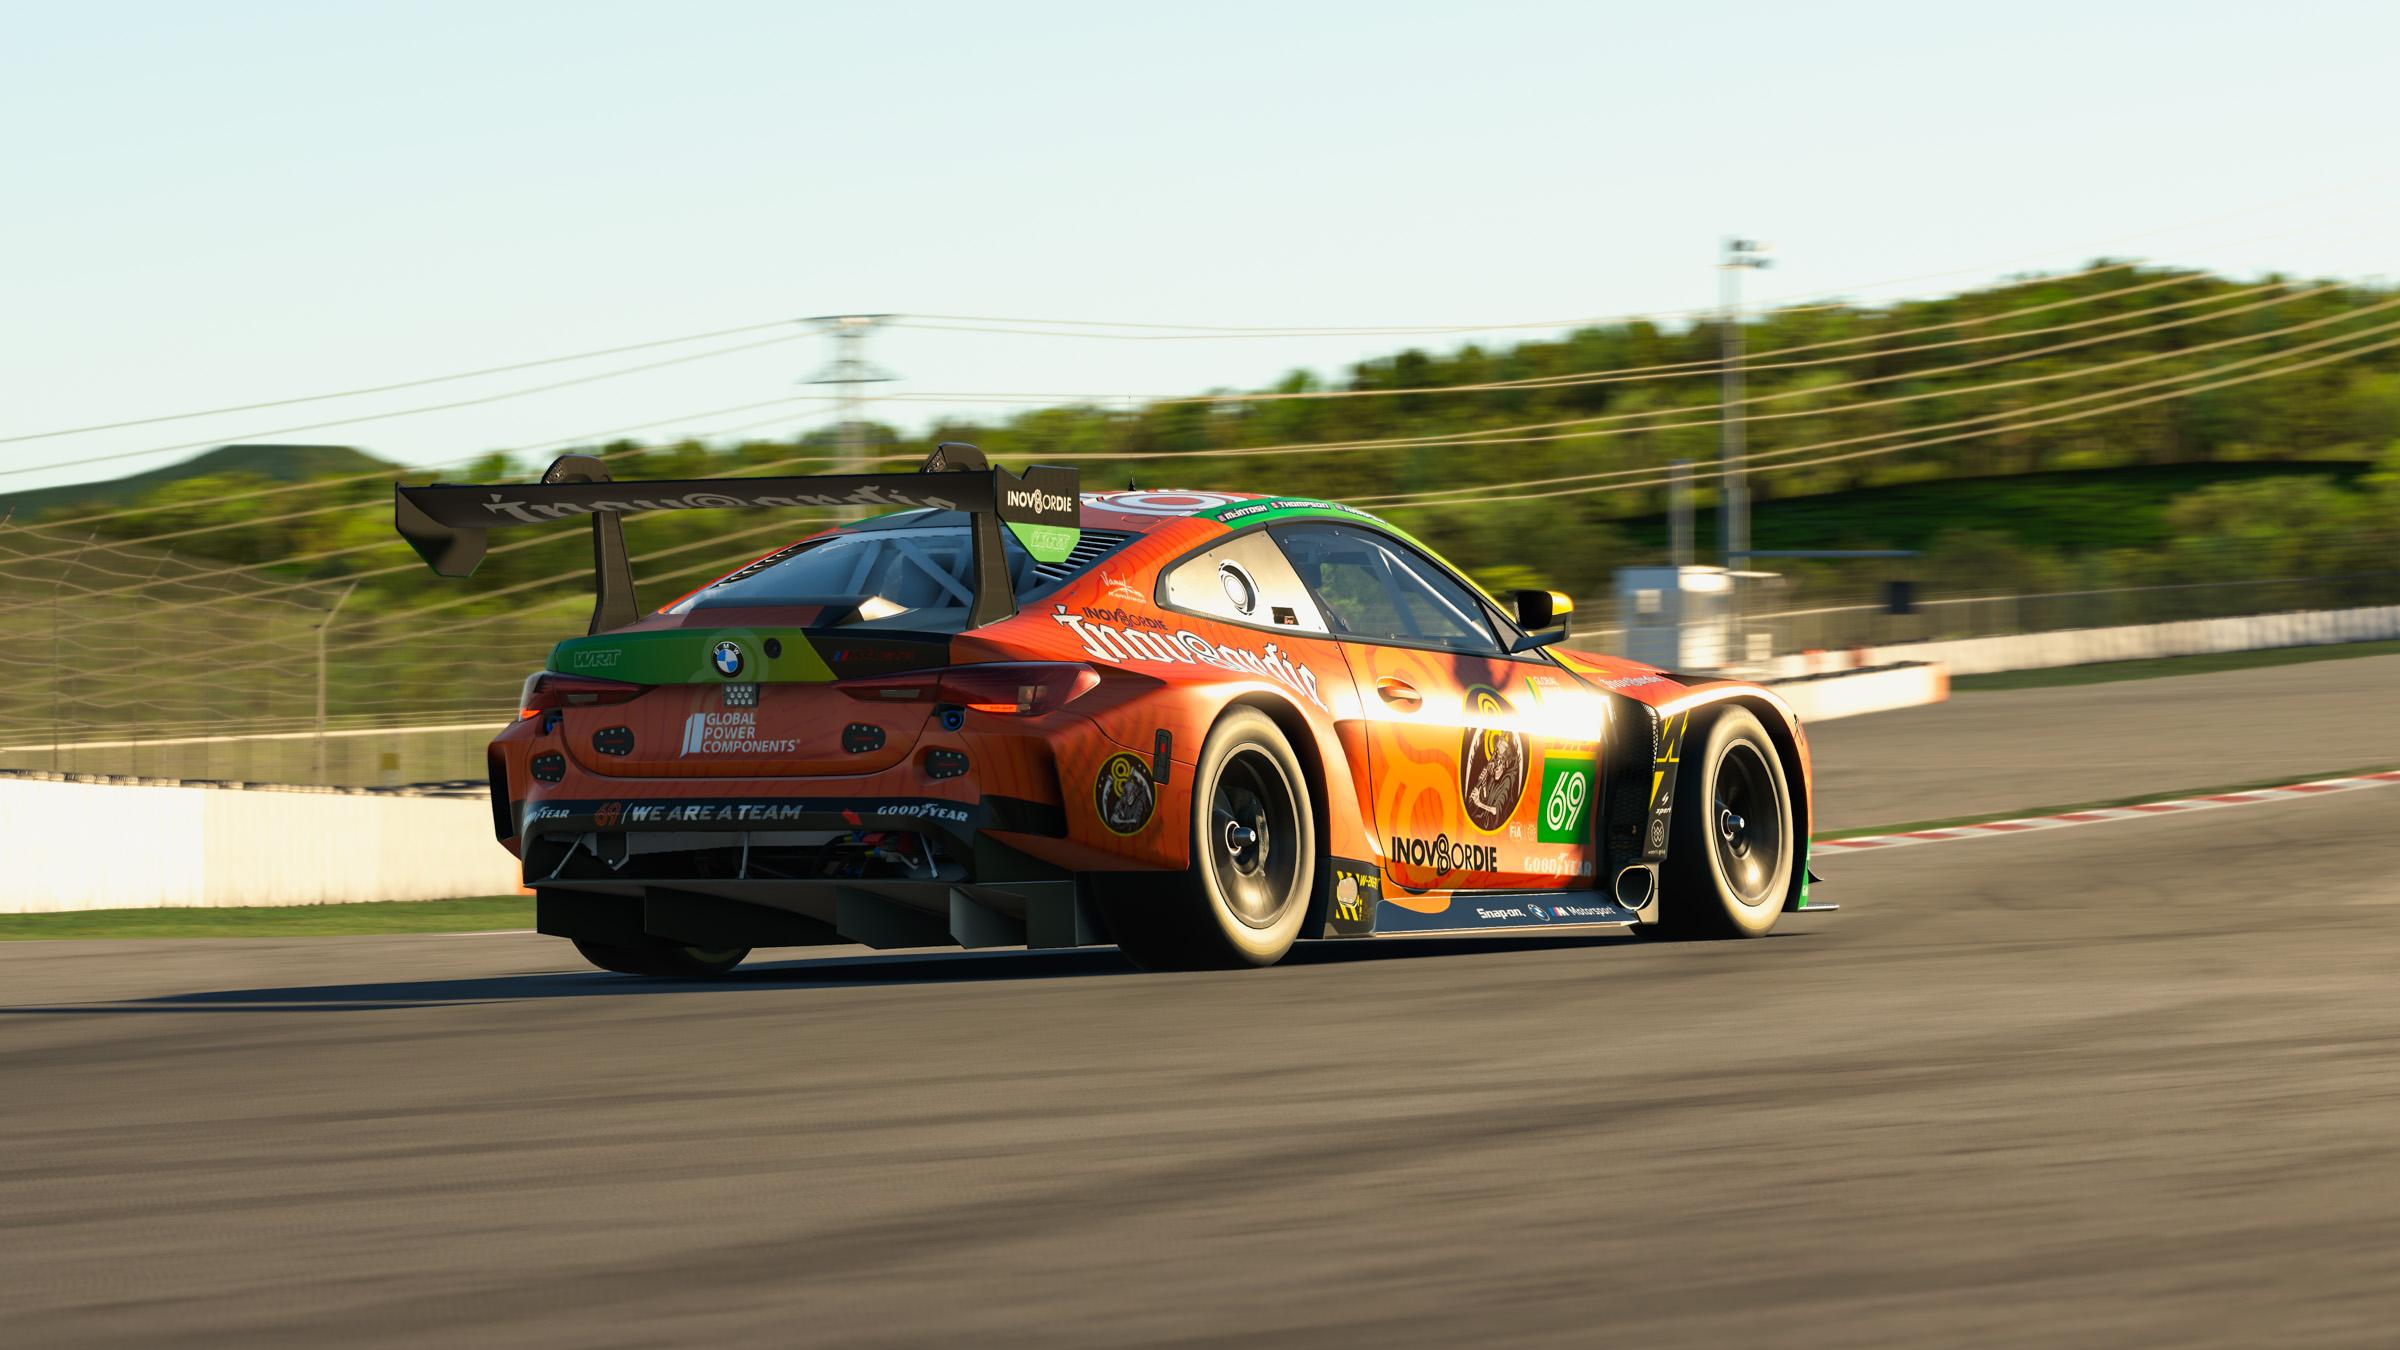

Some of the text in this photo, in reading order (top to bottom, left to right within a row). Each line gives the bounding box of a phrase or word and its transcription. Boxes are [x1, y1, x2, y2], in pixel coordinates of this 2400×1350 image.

[574, 650, 621, 668] WRT
[706, 712, 756, 725] GLOBAL
[704, 726, 756, 739] POWER
[702, 740, 796, 753] COMPONENTS
[1546, 771, 1587, 832] 69
[666, 805, 715, 821] ARE
[716, 805, 733, 821] A
[737, 804, 803, 821] TEAM
[877, 803, 968, 822] GOODYEAR
[1524, 853, 1592, 879] GOODYEAR
[1568, 905, 1617, 919] Motorsport
